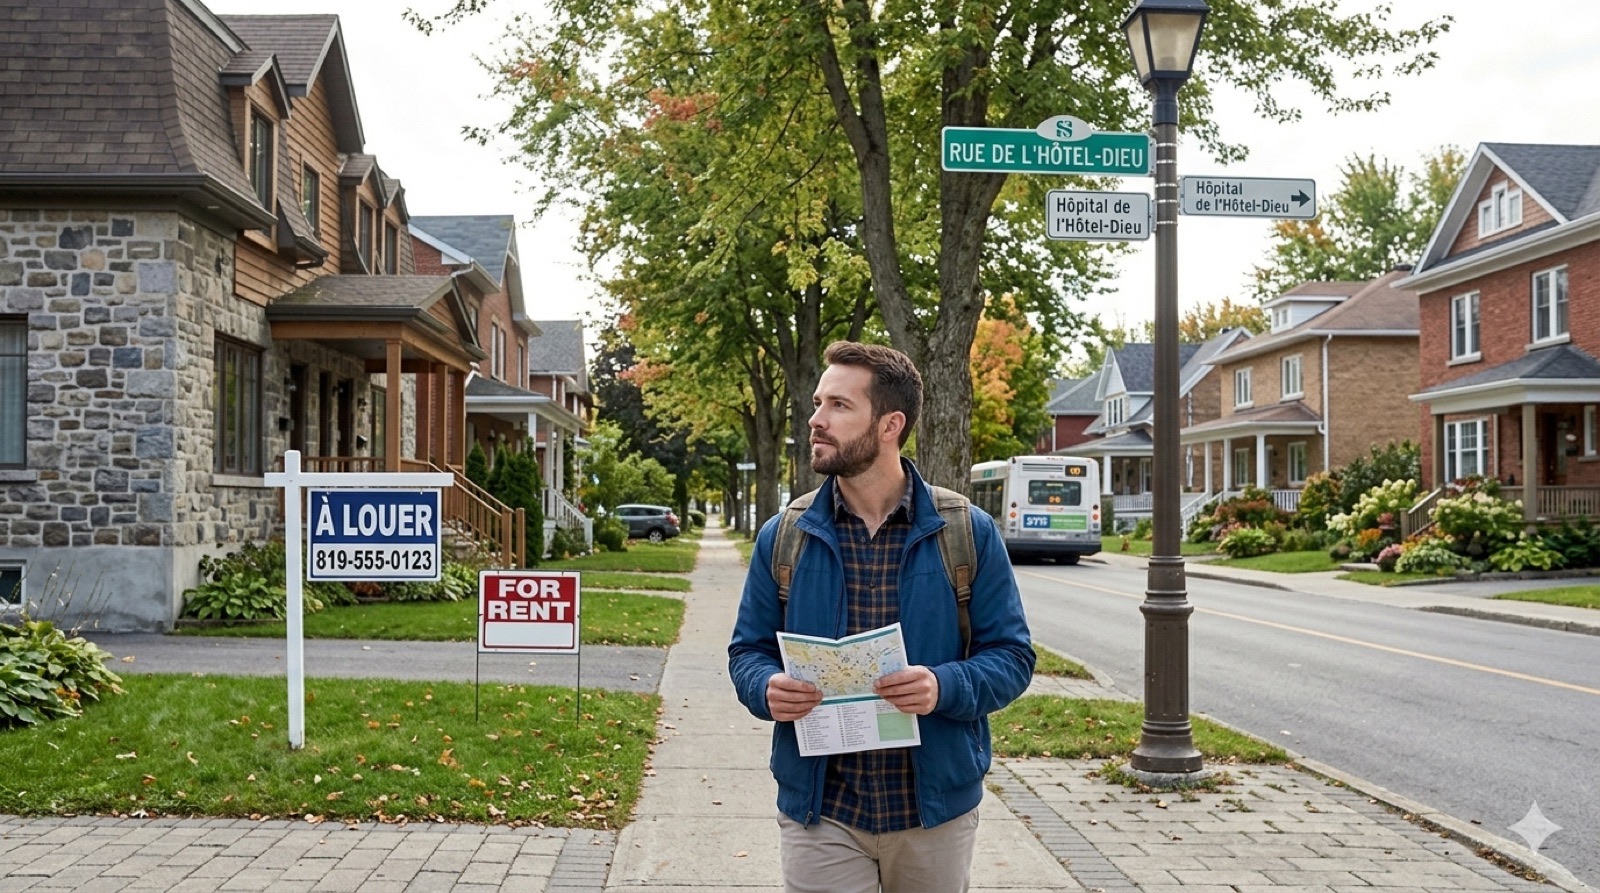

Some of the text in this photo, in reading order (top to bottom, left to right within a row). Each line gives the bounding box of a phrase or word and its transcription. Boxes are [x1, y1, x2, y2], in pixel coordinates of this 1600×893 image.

[949, 141, 1144, 168] RUE DE L'HÔTEL-DIEU
[1196, 180, 1243, 197] Hôpital
[1056, 197, 1131, 216] Hôpital de
[1195, 198, 1289, 213] de l'Hôtel-Dieu
[1056, 217, 1142, 235] l'Hôtel-Dieu
[315, 495, 434, 537] À LOUER
[316, 549, 432, 571] 819-555-0123
[499, 578, 561, 599] FOR
[487, 600, 571, 621] RENT
